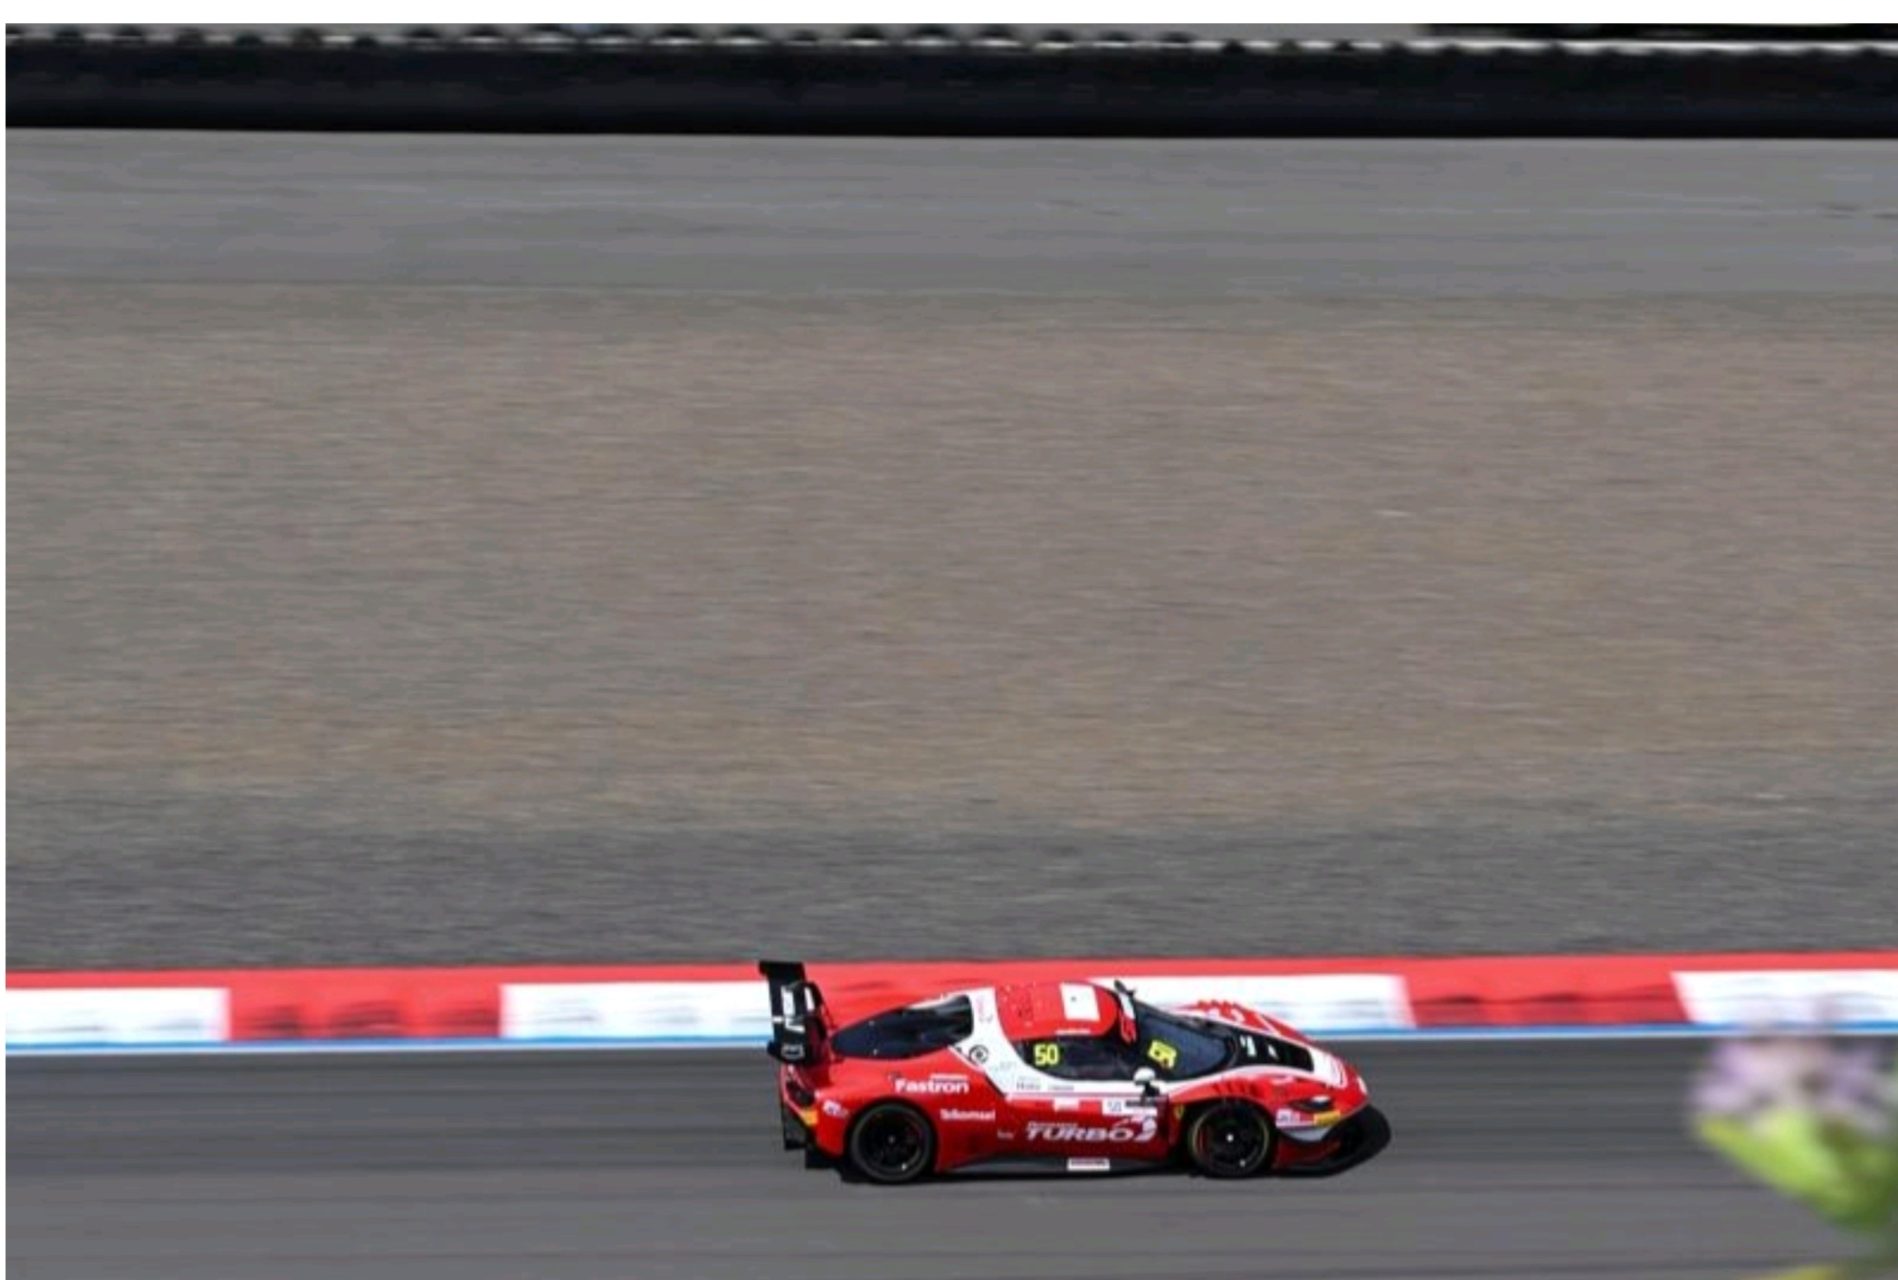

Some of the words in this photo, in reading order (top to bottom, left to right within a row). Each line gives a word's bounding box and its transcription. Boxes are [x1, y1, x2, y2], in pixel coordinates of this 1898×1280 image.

[1033, 1042, 1061, 1067] 50
[894, 1078, 971, 1094] Fastron
[1025, 1124, 1135, 1143] TURBO
